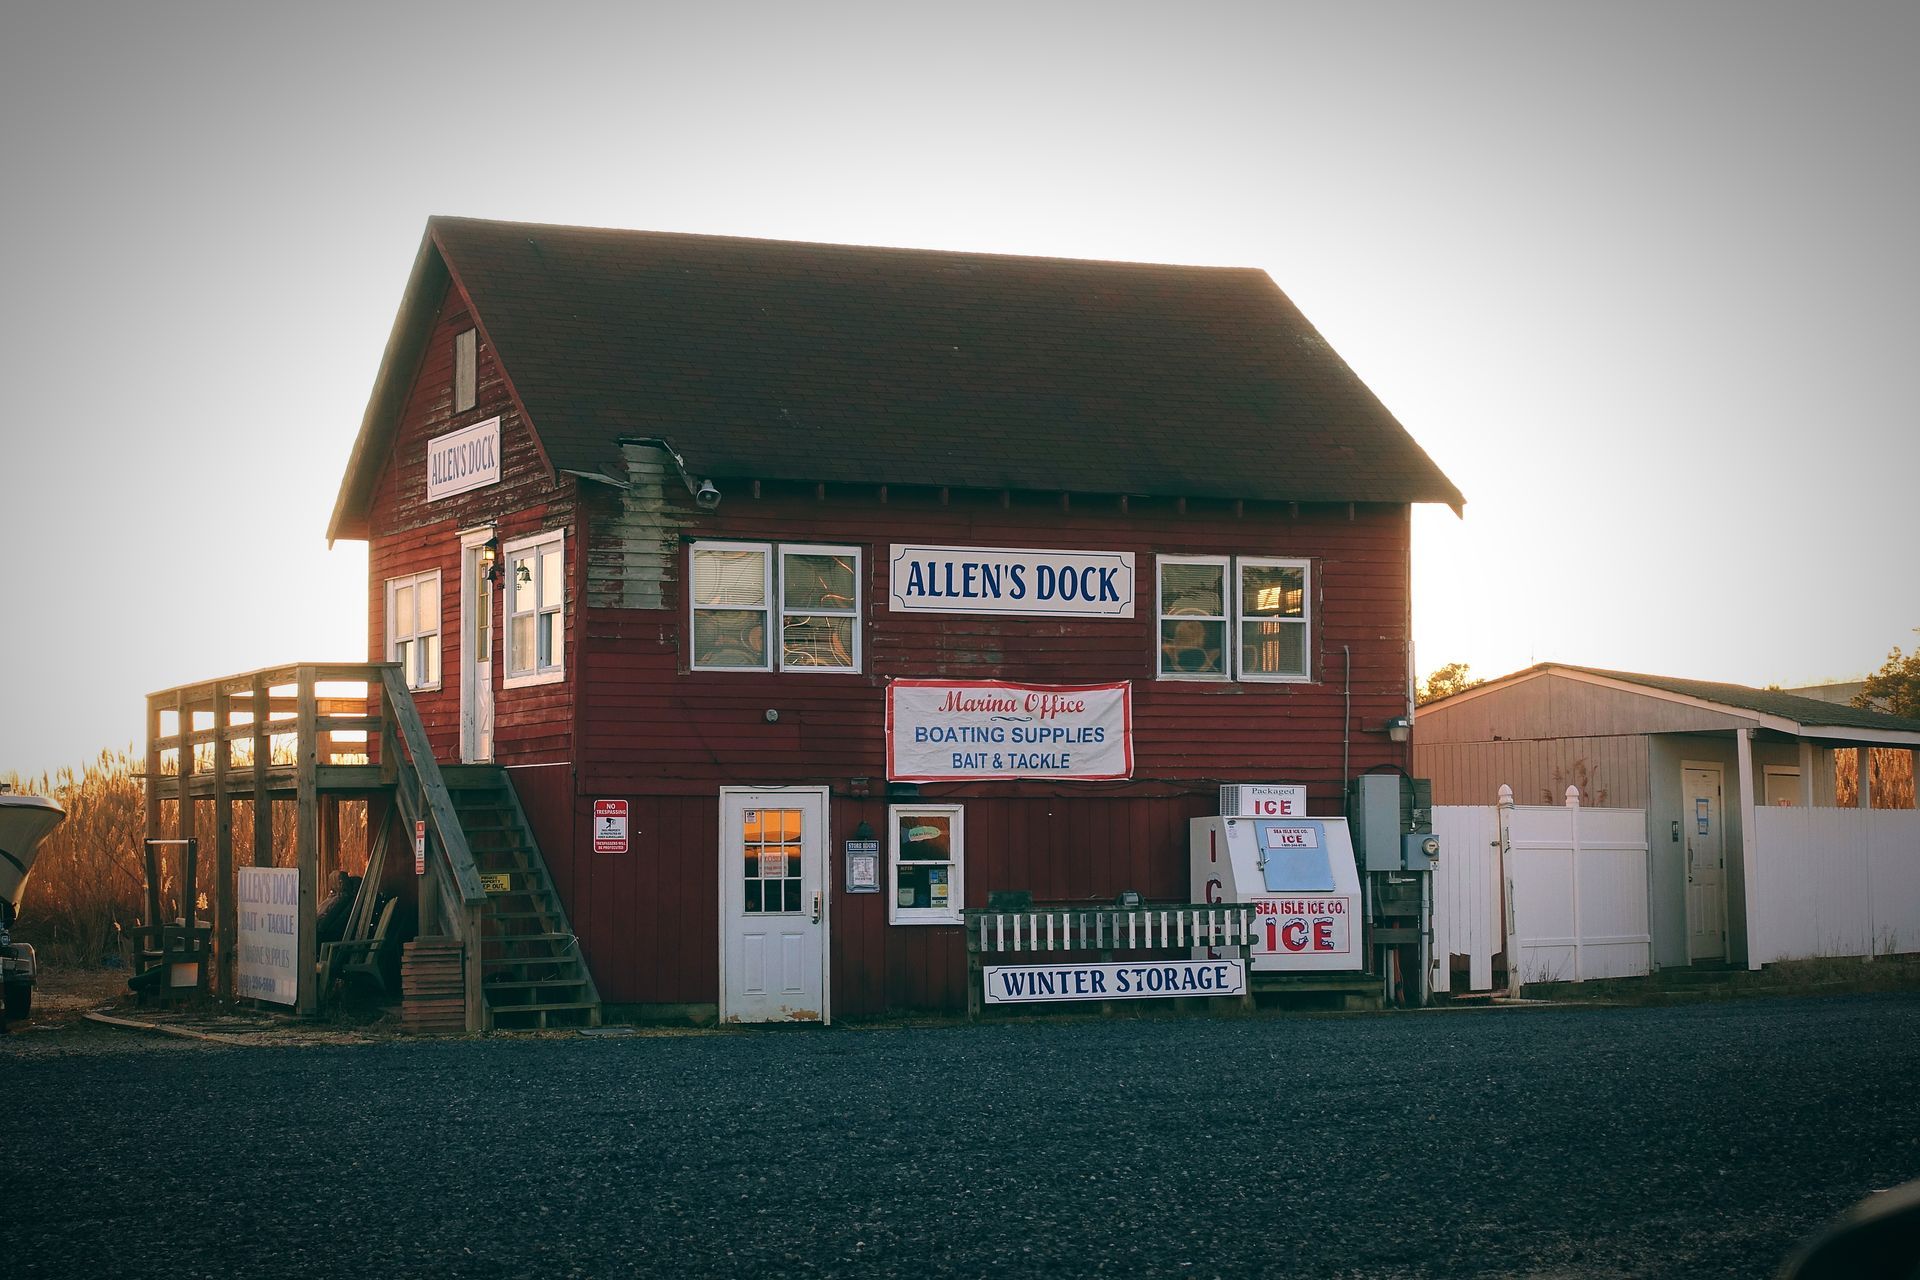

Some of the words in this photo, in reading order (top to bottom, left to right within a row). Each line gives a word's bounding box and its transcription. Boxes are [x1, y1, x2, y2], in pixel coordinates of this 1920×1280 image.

[432, 443, 467, 486] ALLEN'S
[468, 434, 495, 475] DOCK
[906, 561, 1026, 600] ALLEN'S
[1036, 565, 1120, 602] DOCK
[938, 691, 1017, 713] Marina
[1024, 693, 1086, 720] Office
[915, 727, 1005, 743] BOATING
[1011, 727, 1105, 743] SUPPLIES
[952, 753, 988, 769] BAIT
[992, 753, 1003, 769] &
[1008, 753, 1071, 769] TACKLE
[1252, 787, 1296, 797] Packaged
[1254, 799, 1292, 815] ICE
[1281, 834, 1303, 843] ICE
[273, 873, 298, 905] DOCK
[1256, 901, 1278, 915] SEA
[1281, 901, 1304, 914] ISLE
[1308, 901, 1325, 914] ICE
[1327, 901, 1346, 914] CO.
[267, 913, 294, 935] TACKLE
[1265, 917, 1335, 951] ICE
[1001, 970, 1108, 996] WINTER
[1116, 966, 1230, 993] STORAGE
